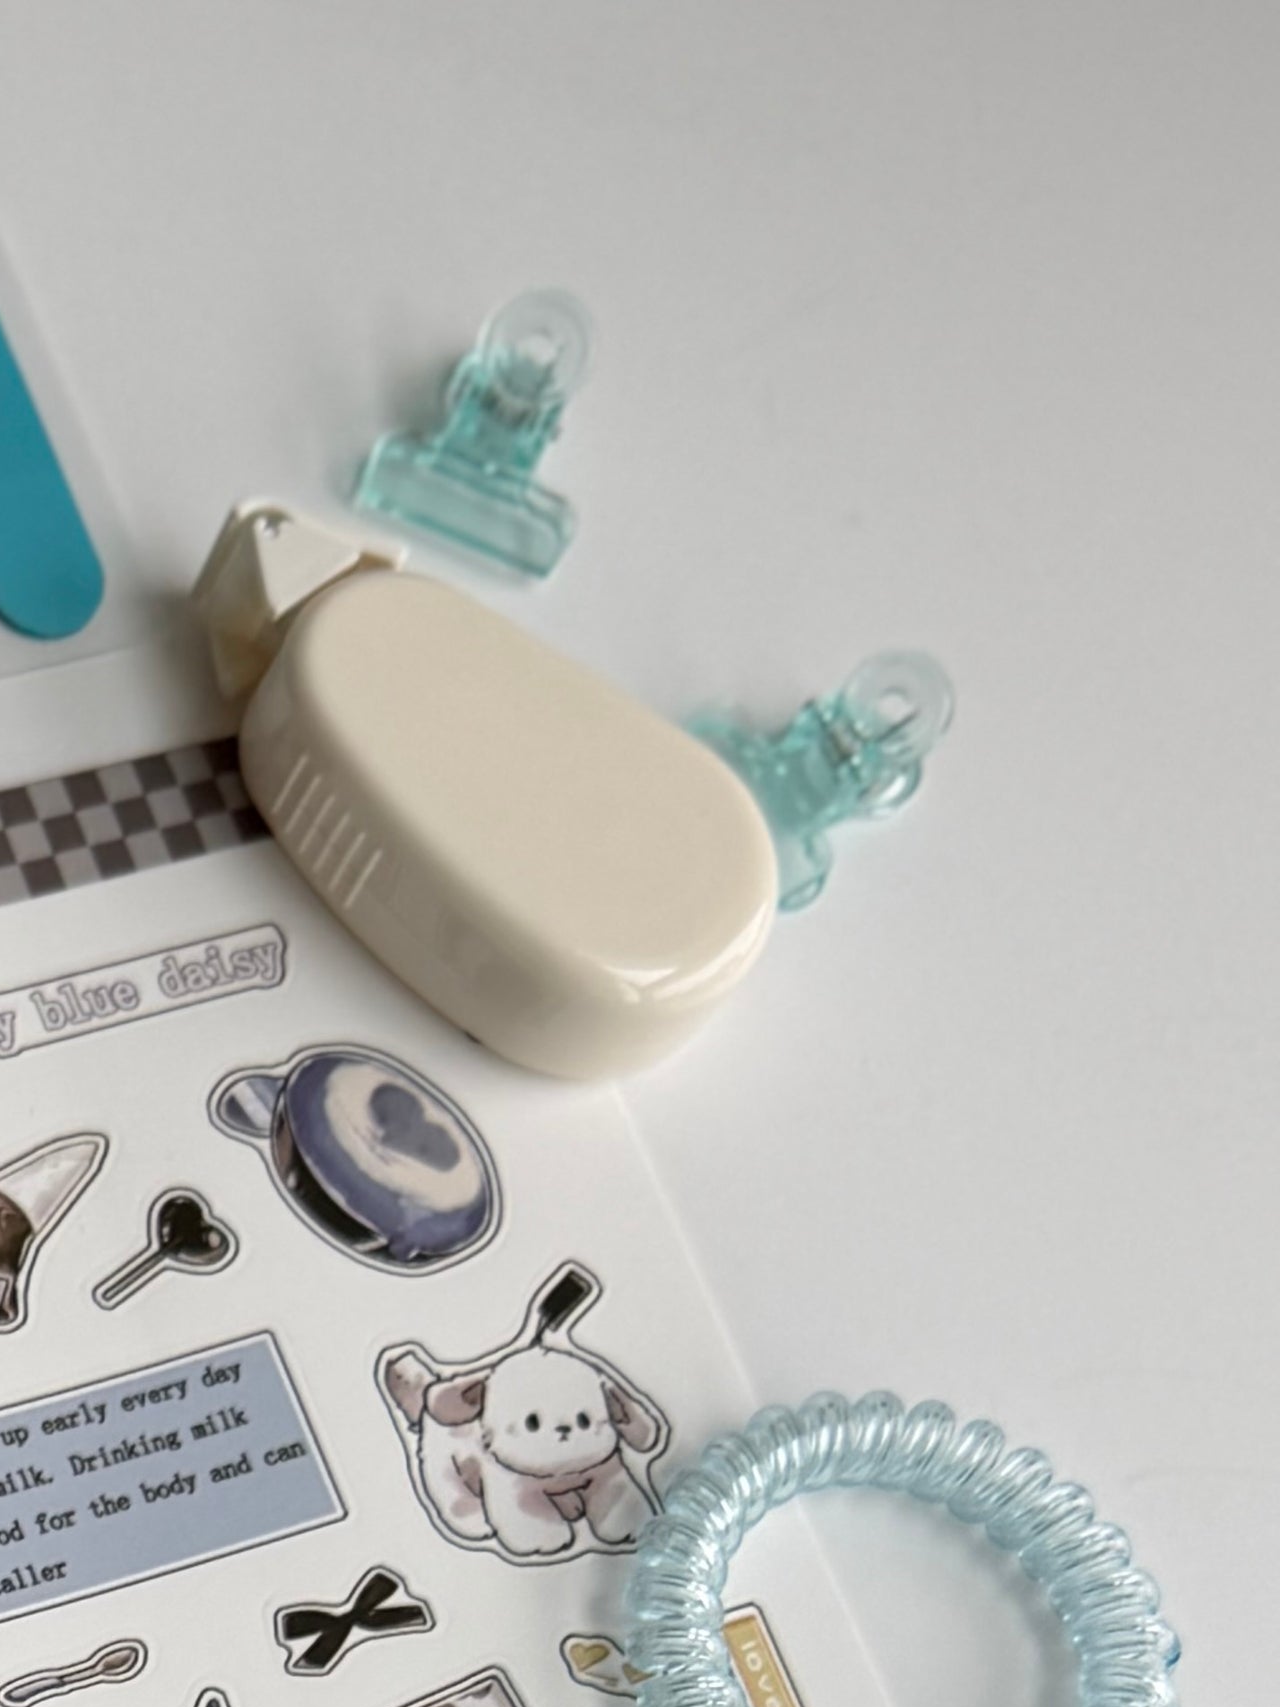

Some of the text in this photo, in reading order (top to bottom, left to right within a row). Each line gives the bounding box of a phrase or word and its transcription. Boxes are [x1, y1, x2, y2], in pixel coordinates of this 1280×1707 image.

[30, 976, 142, 1032] blue
[158, 936, 284, 999] daisy
[0, 1427, 29, 1447] up
[41, 1403, 106, 1435] early
[121, 1379, 187, 1411] every
[201, 1363, 241, 1387] day
[68, 1430, 182, 1476] Drinking
[190, 1408, 248, 1440] milk
[35, 1510, 75, 1535] for
[88, 1494, 131, 1518] the
[139, 1473, 196, 1503] body
[210, 1452, 253, 1483] and
[264, 1442, 307, 1466] can
